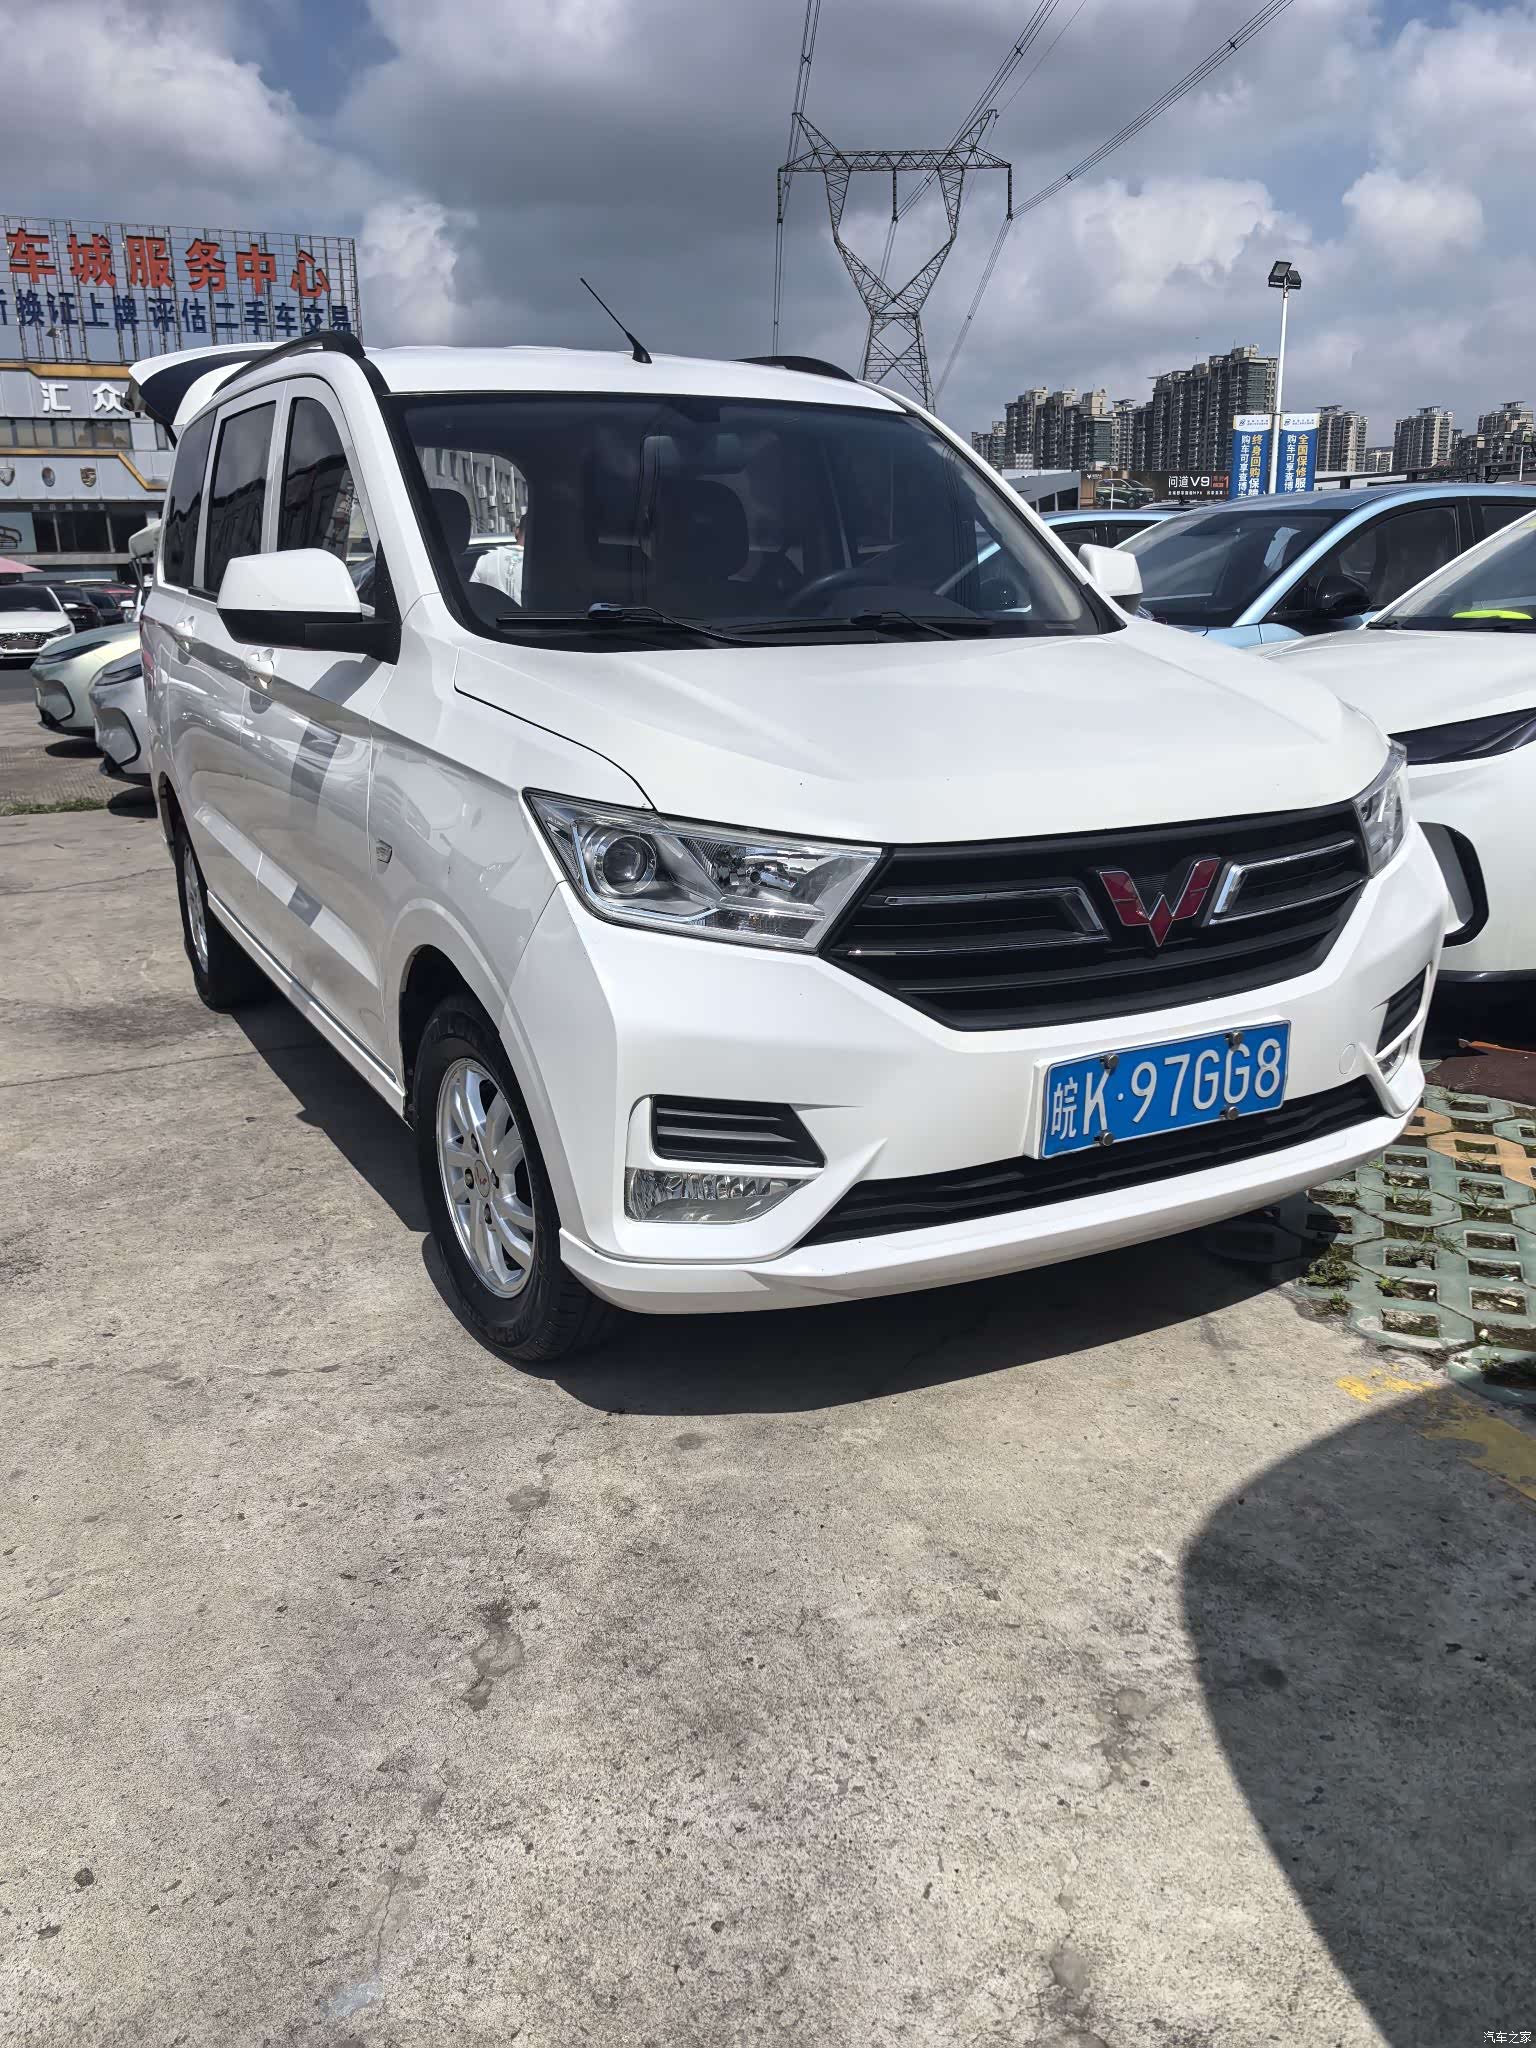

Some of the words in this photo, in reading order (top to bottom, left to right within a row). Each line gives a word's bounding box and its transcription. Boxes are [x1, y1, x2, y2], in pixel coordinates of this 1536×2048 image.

[6, 227, 331, 298] 车城服务中心
[40, 381, 123, 413] 汇众
[1284, 434, 1297, 492] 购车可享查博
